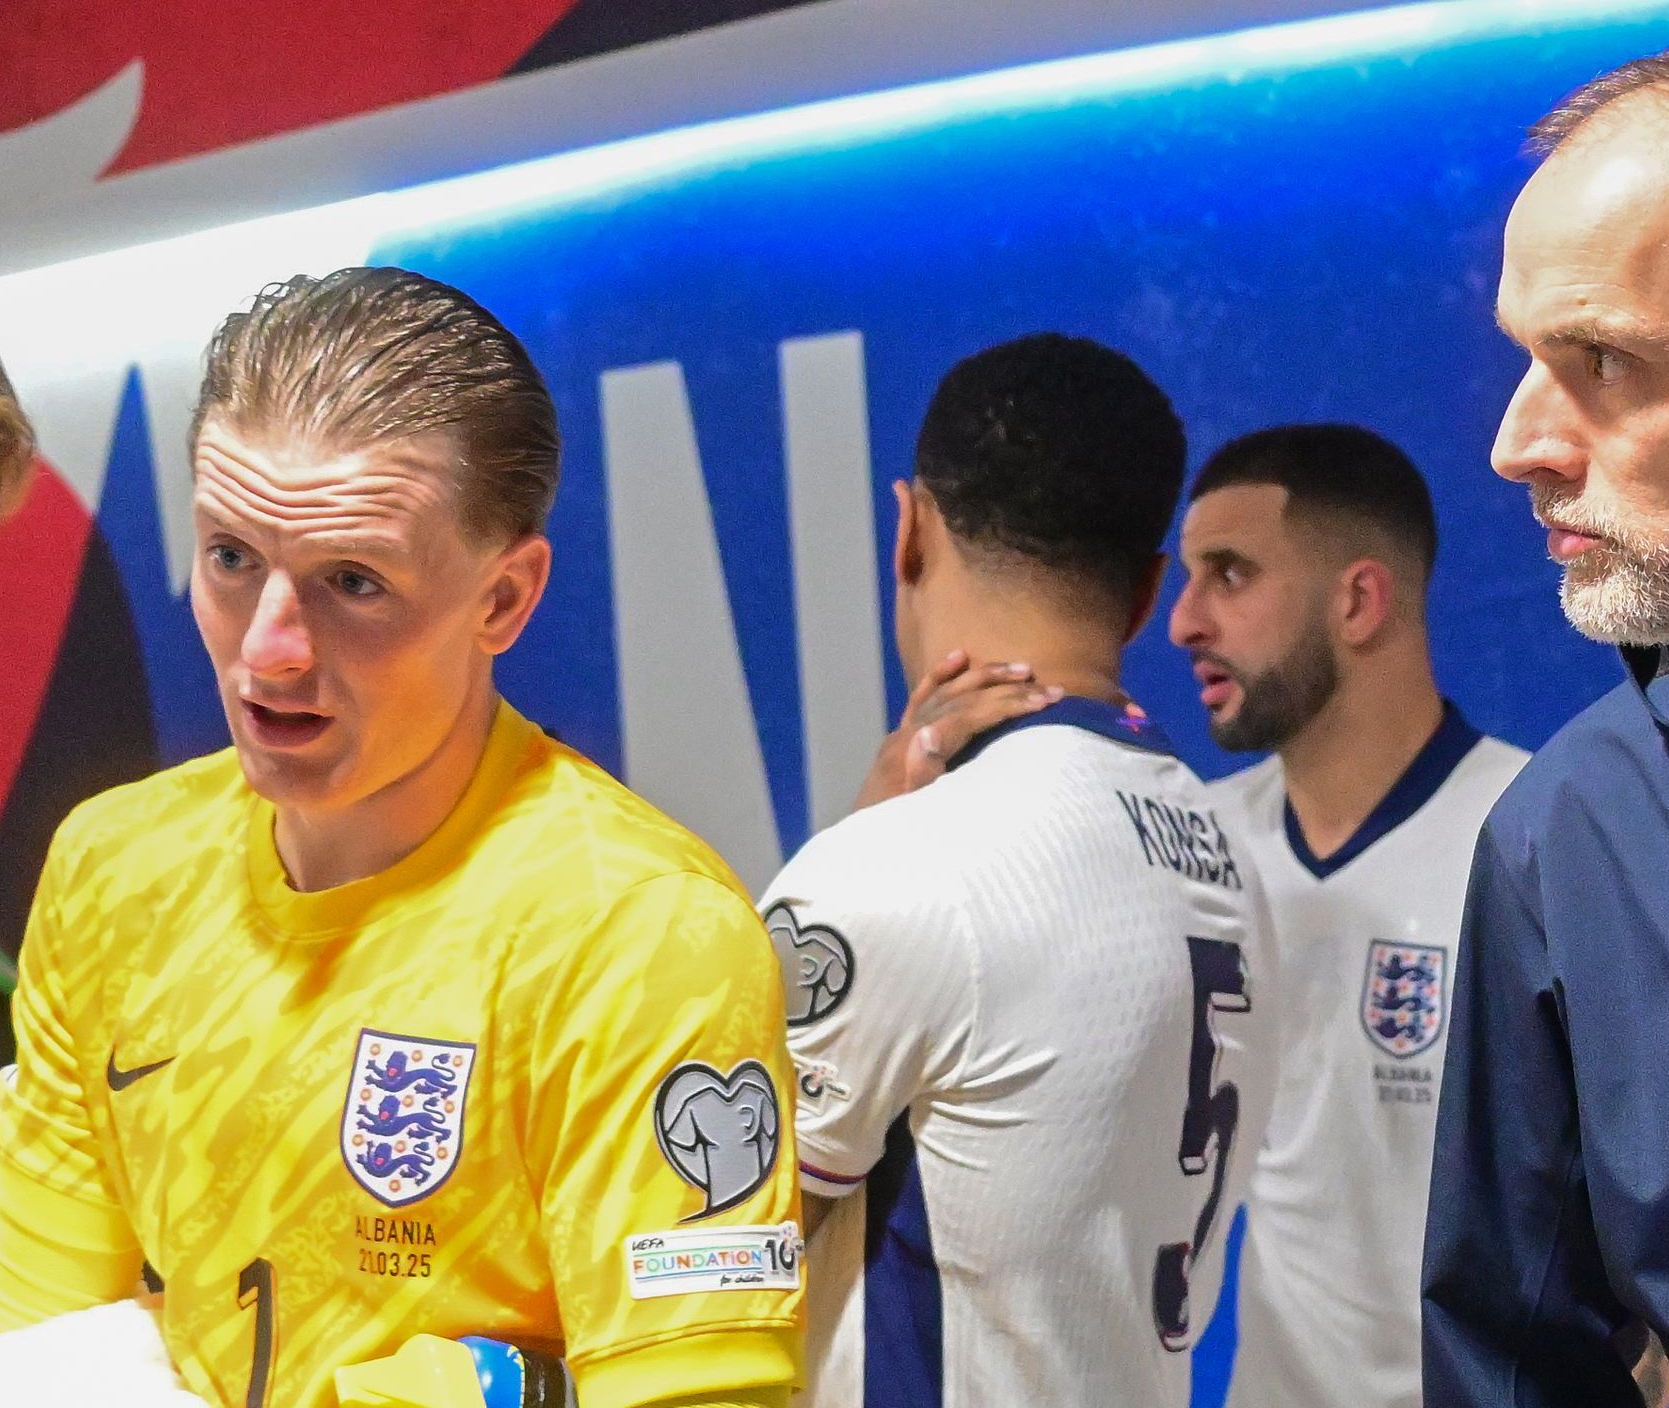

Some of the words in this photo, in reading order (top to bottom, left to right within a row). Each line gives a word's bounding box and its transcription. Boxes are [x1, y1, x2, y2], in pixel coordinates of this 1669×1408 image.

[1115, 789, 1242, 890] KONSA
[1152, 934, 1252, 1352] 5
[356, 1215, 436, 1247] ALBANIA
[632, 1237, 664, 1251] UEFA
[634, 1250, 763, 1274] FOUNDATION
